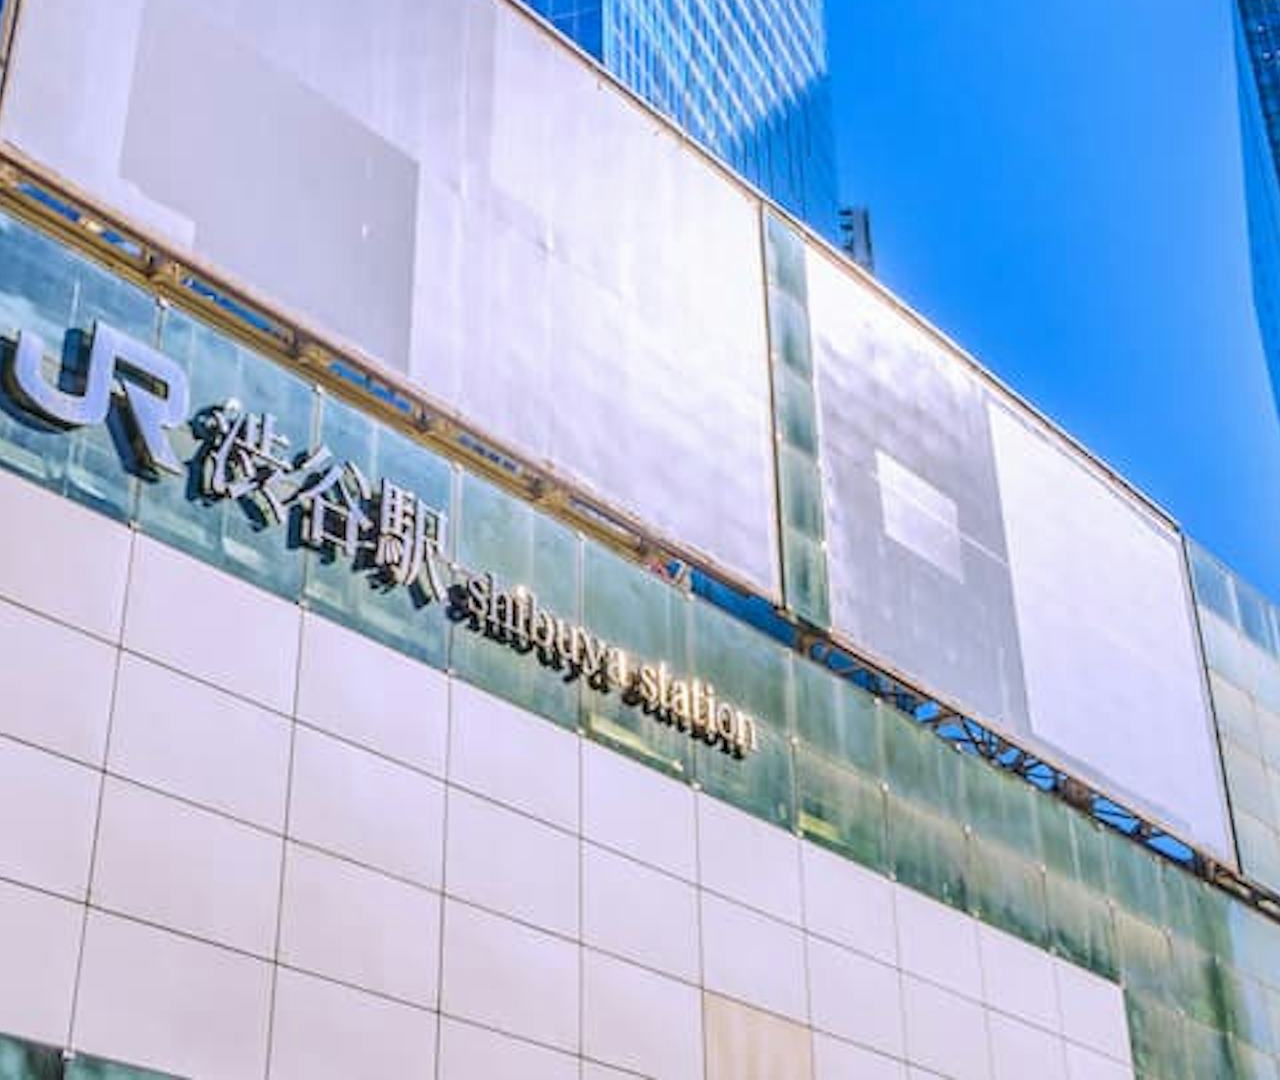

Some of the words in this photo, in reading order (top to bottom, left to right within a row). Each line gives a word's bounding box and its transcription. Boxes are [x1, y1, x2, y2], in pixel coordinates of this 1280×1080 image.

[14, 321, 191, 477] JR
[198, 396, 449, 606] 渋谷駅
[467, 570, 630, 689] shibuya
[639, 660, 758, 753] station
